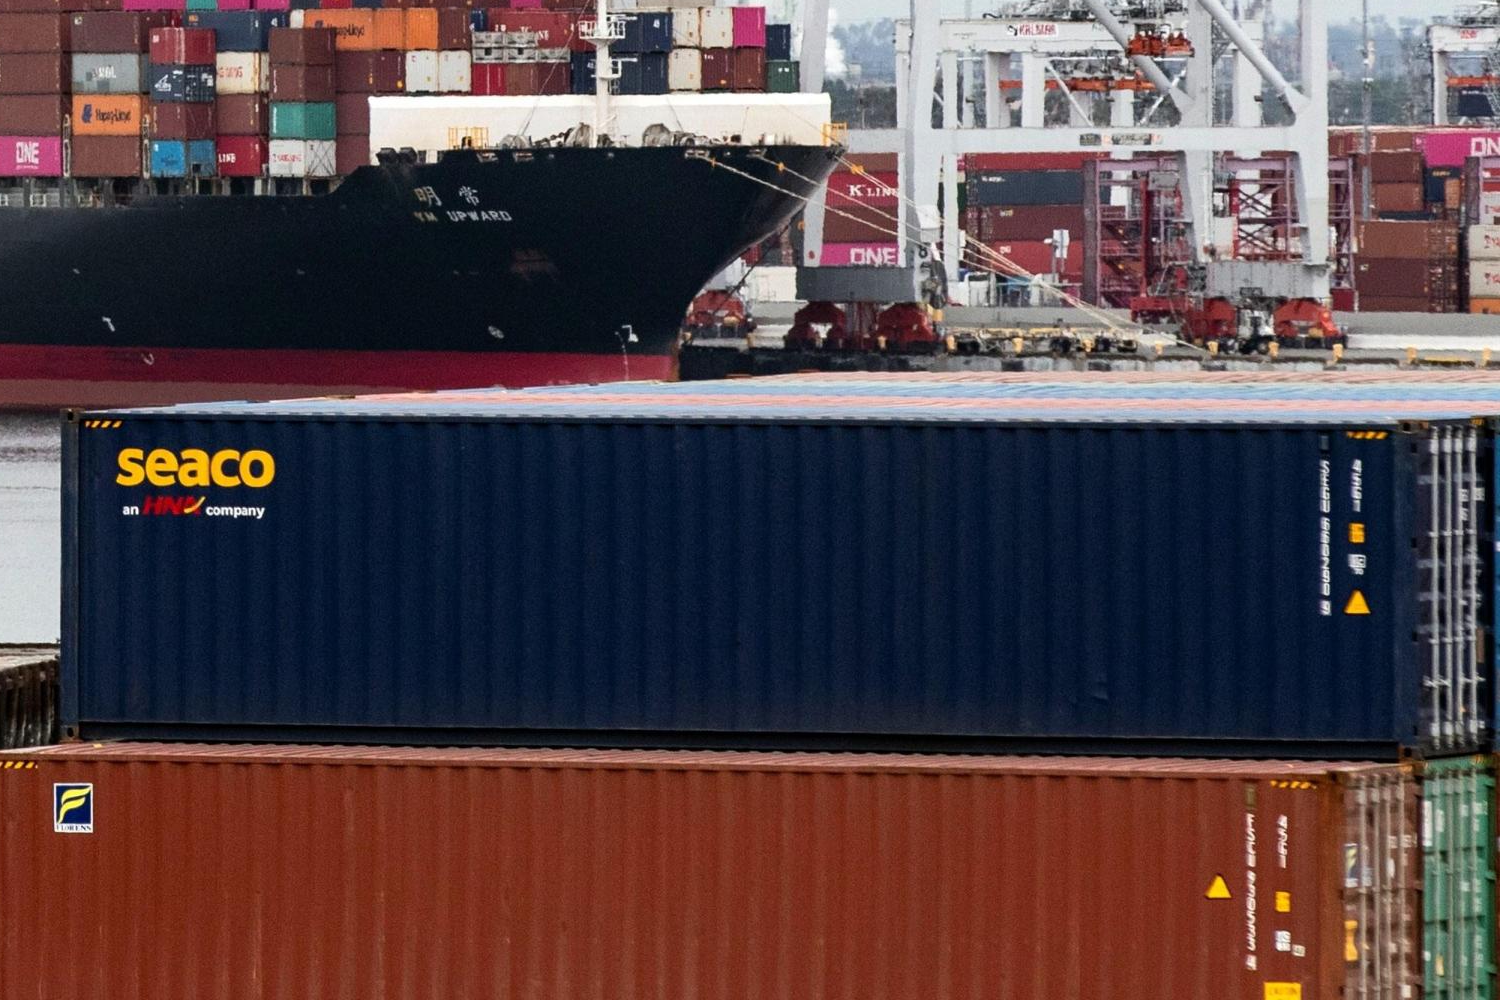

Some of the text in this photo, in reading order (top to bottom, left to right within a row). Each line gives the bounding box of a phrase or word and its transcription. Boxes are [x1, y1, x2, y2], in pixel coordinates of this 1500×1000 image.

[16, 141, 39, 164] ONE
[414, 211, 512, 222] YM UPWARD
[851, 247, 896, 265] ONE
[116, 447, 276, 488] seaco
[122, 496, 266, 520] an HNA company
